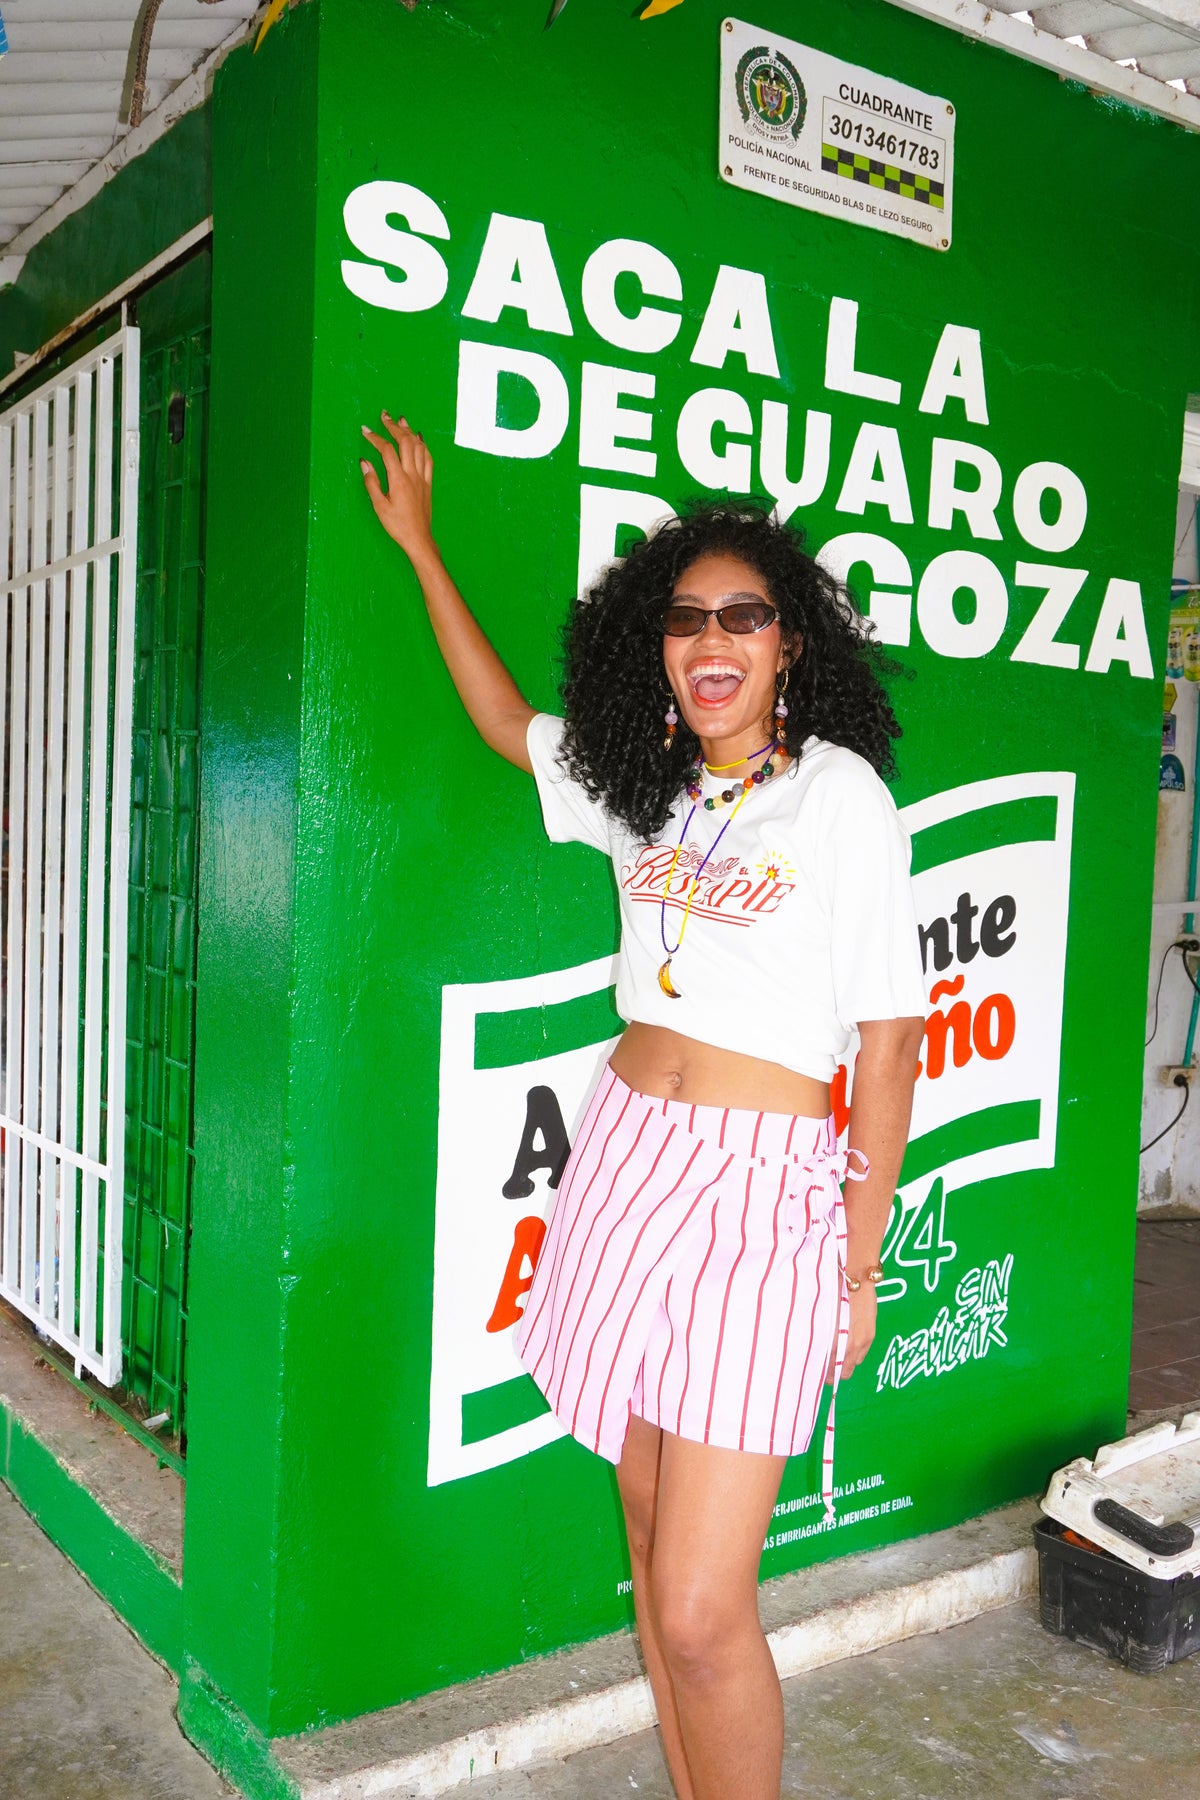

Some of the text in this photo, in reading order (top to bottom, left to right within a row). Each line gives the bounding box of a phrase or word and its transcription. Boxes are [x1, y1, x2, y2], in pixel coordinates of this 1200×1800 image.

[839, 83, 933, 131] CUADRANTE
[728, 134, 813, 172] POLICÍA NACIONAL
[829, 114, 940, 170] 3013461783
[743, 164, 933, 233] FRENTE DE SEGURIDAD BLAS DE LEZO SEGURO
[340, 180, 990, 426] SACA LA
[454, 339, 1088, 553] DE GUARO
[813, 531, 1155, 679] GOZA
[845, 1482, 855, 1496] LA
[856, 1473, 885, 1492] SALUD.
[776, 1518, 837, 1547] EMBRIAGANTES
[880, 1502, 890, 1514] DE
[892, 1495, 914, 1512] EDAD.
